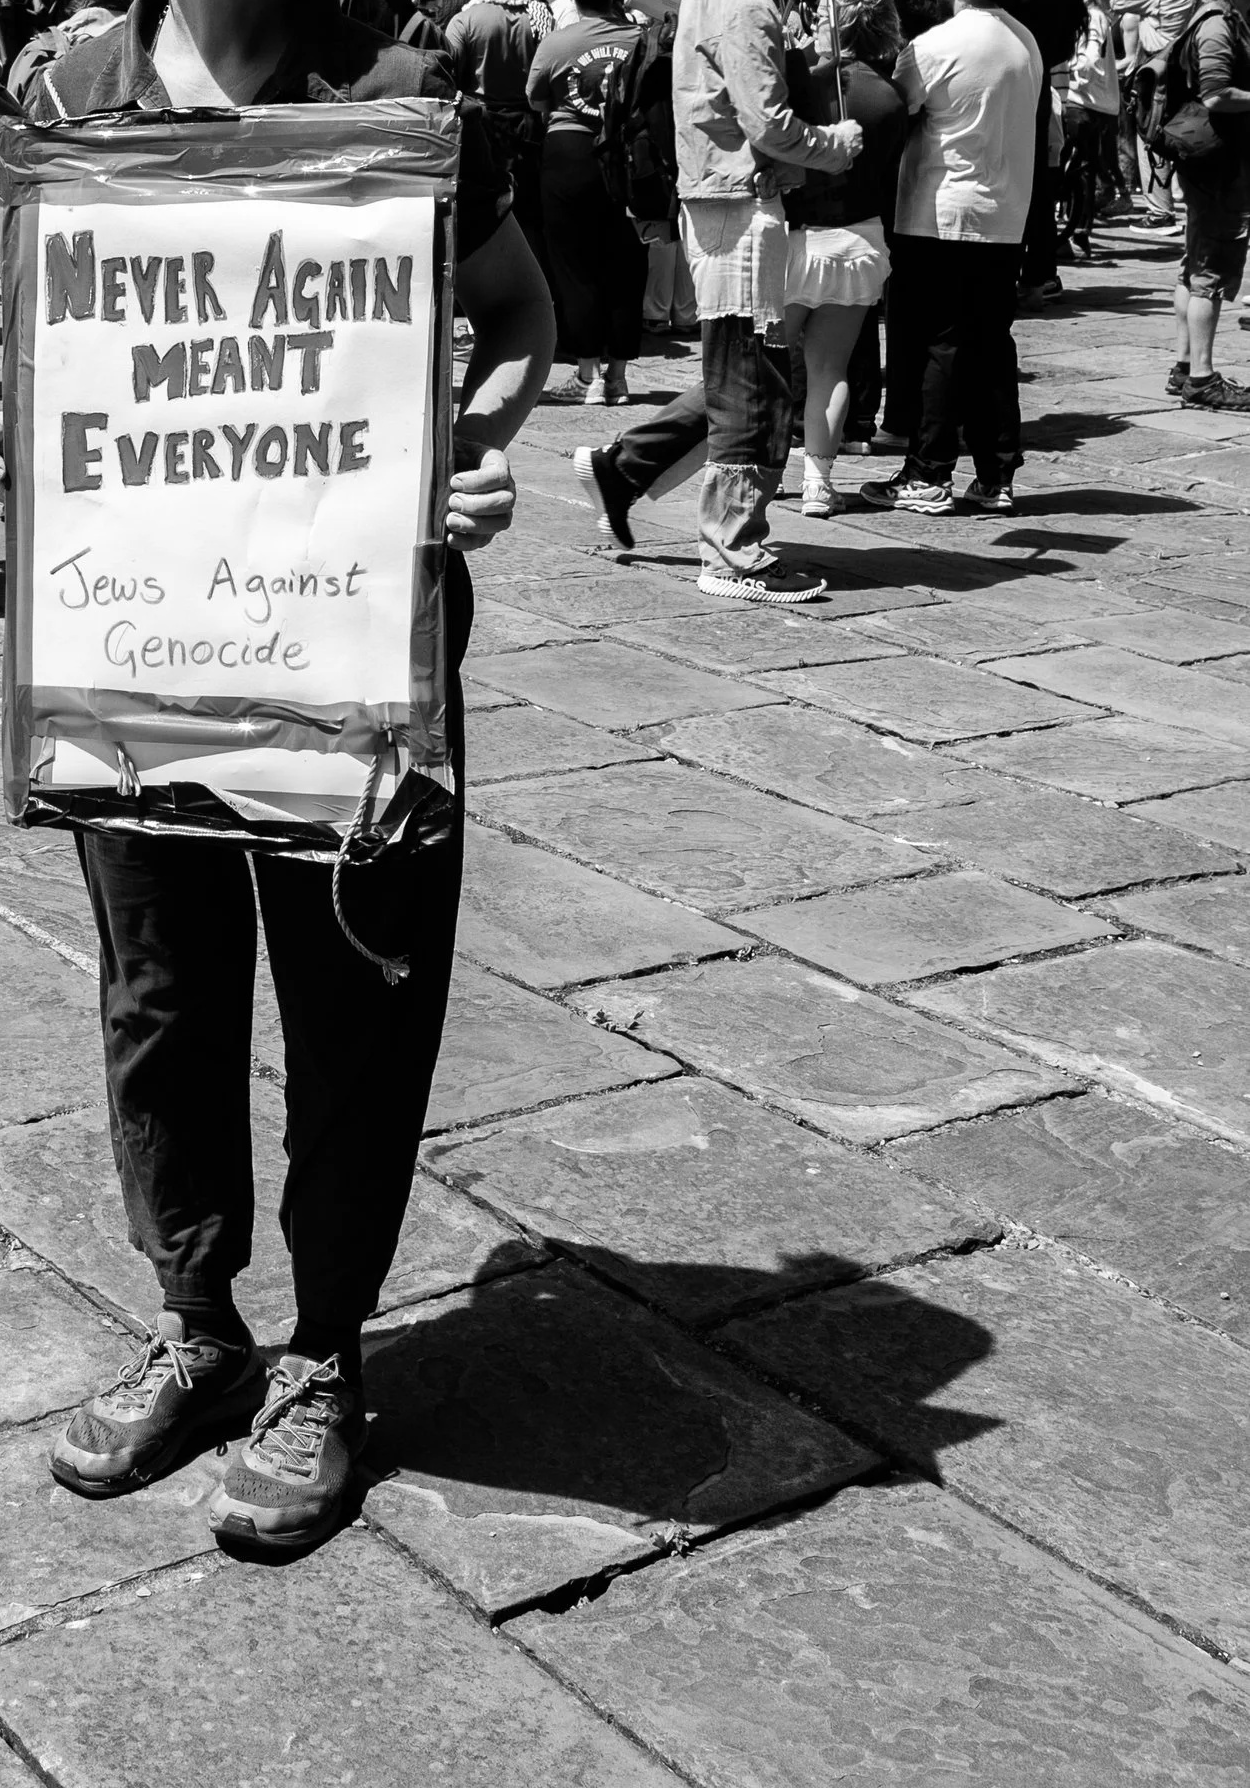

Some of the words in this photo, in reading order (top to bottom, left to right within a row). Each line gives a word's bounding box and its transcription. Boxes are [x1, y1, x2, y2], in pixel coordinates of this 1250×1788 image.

[577, 52, 593, 66] WE
[590, 46, 611, 59] WILL
[45, 230, 227, 325] NEVER
[250, 229, 413, 330] AGAIN
[131, 331, 335, 403] MEANT
[61, 412, 371, 493] EVERYONE
[49, 547, 166, 610] Jews
[207, 557, 368, 626] Against
[104, 620, 312, 677] Genocide
